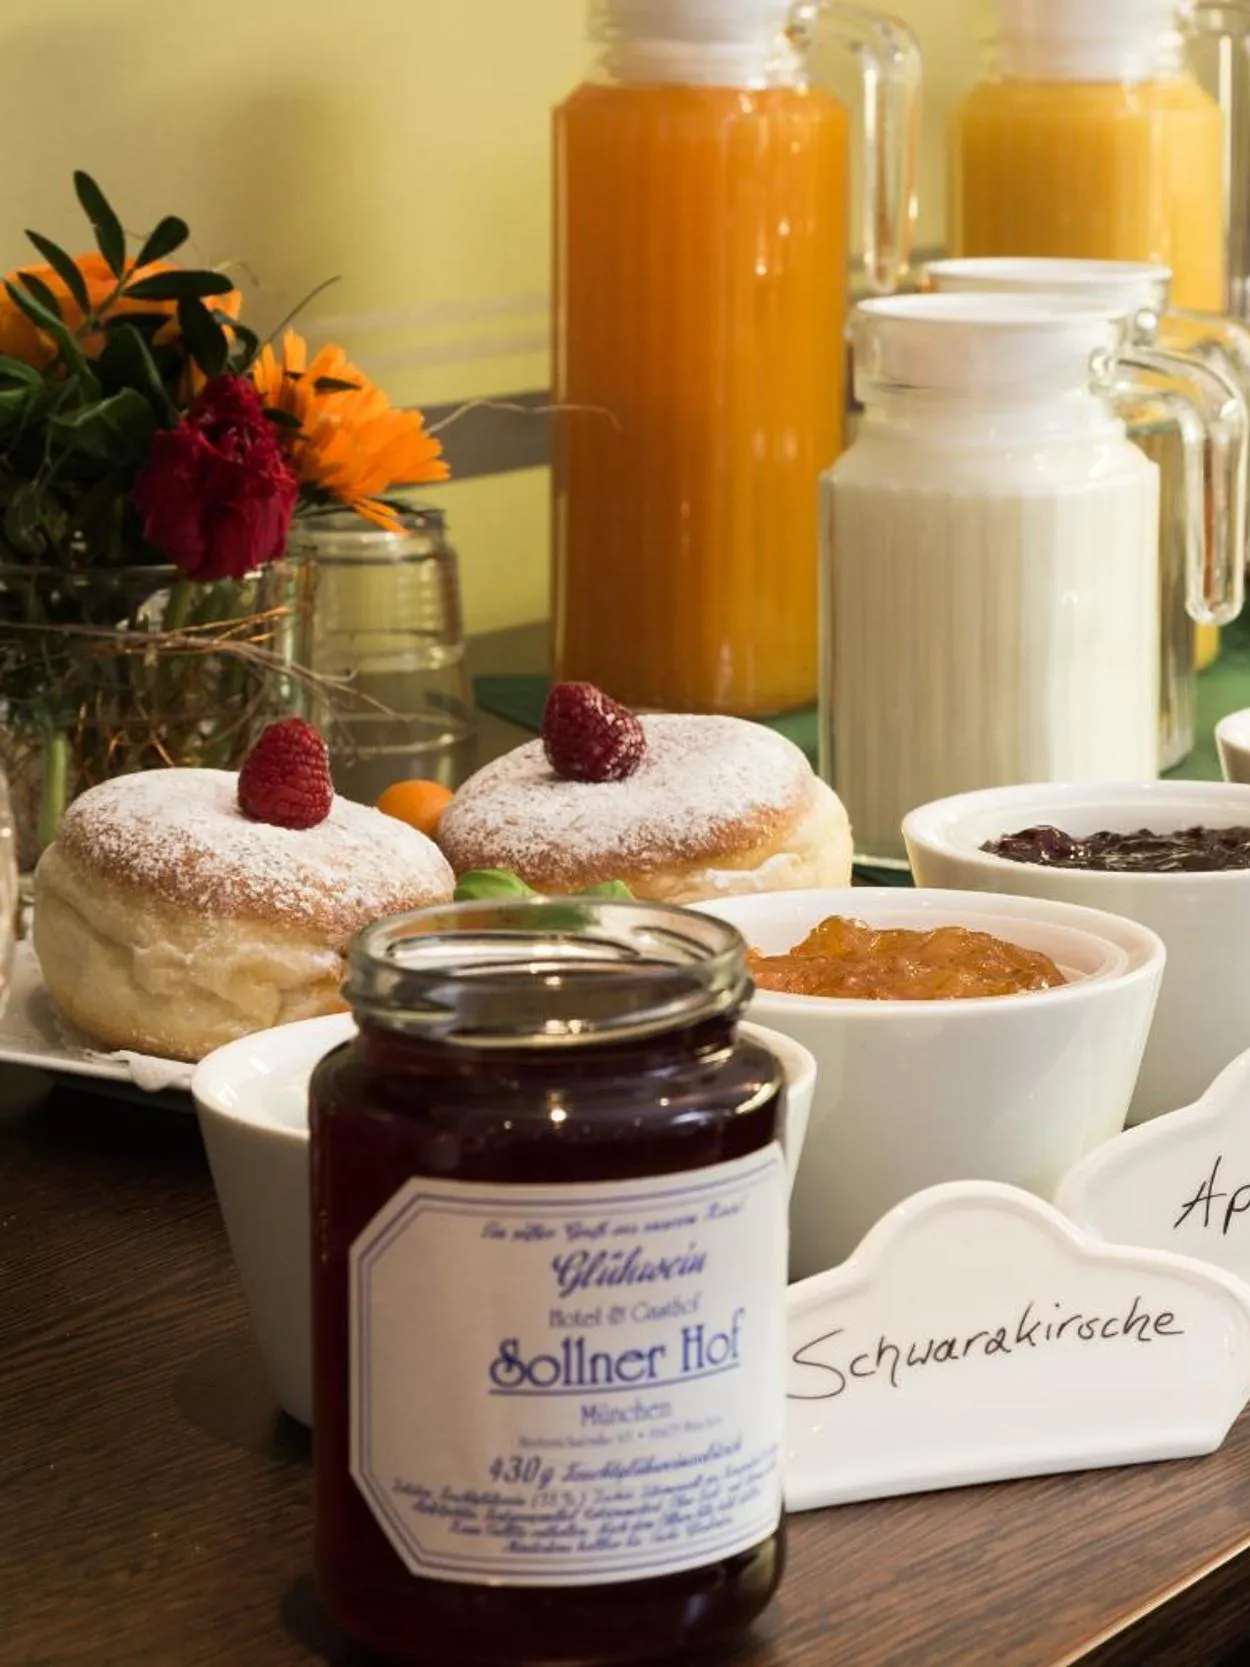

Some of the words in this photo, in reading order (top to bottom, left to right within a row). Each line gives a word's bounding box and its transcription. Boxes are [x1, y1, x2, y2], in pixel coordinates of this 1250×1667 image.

[551, 1241, 708, 1299] Glühwein
[549, 1304, 603, 1328] Hotel
[488, 1335, 667, 1388] Sollner
[680, 1306, 746, 1373] Hof
[579, 1397, 673, 1428] München
